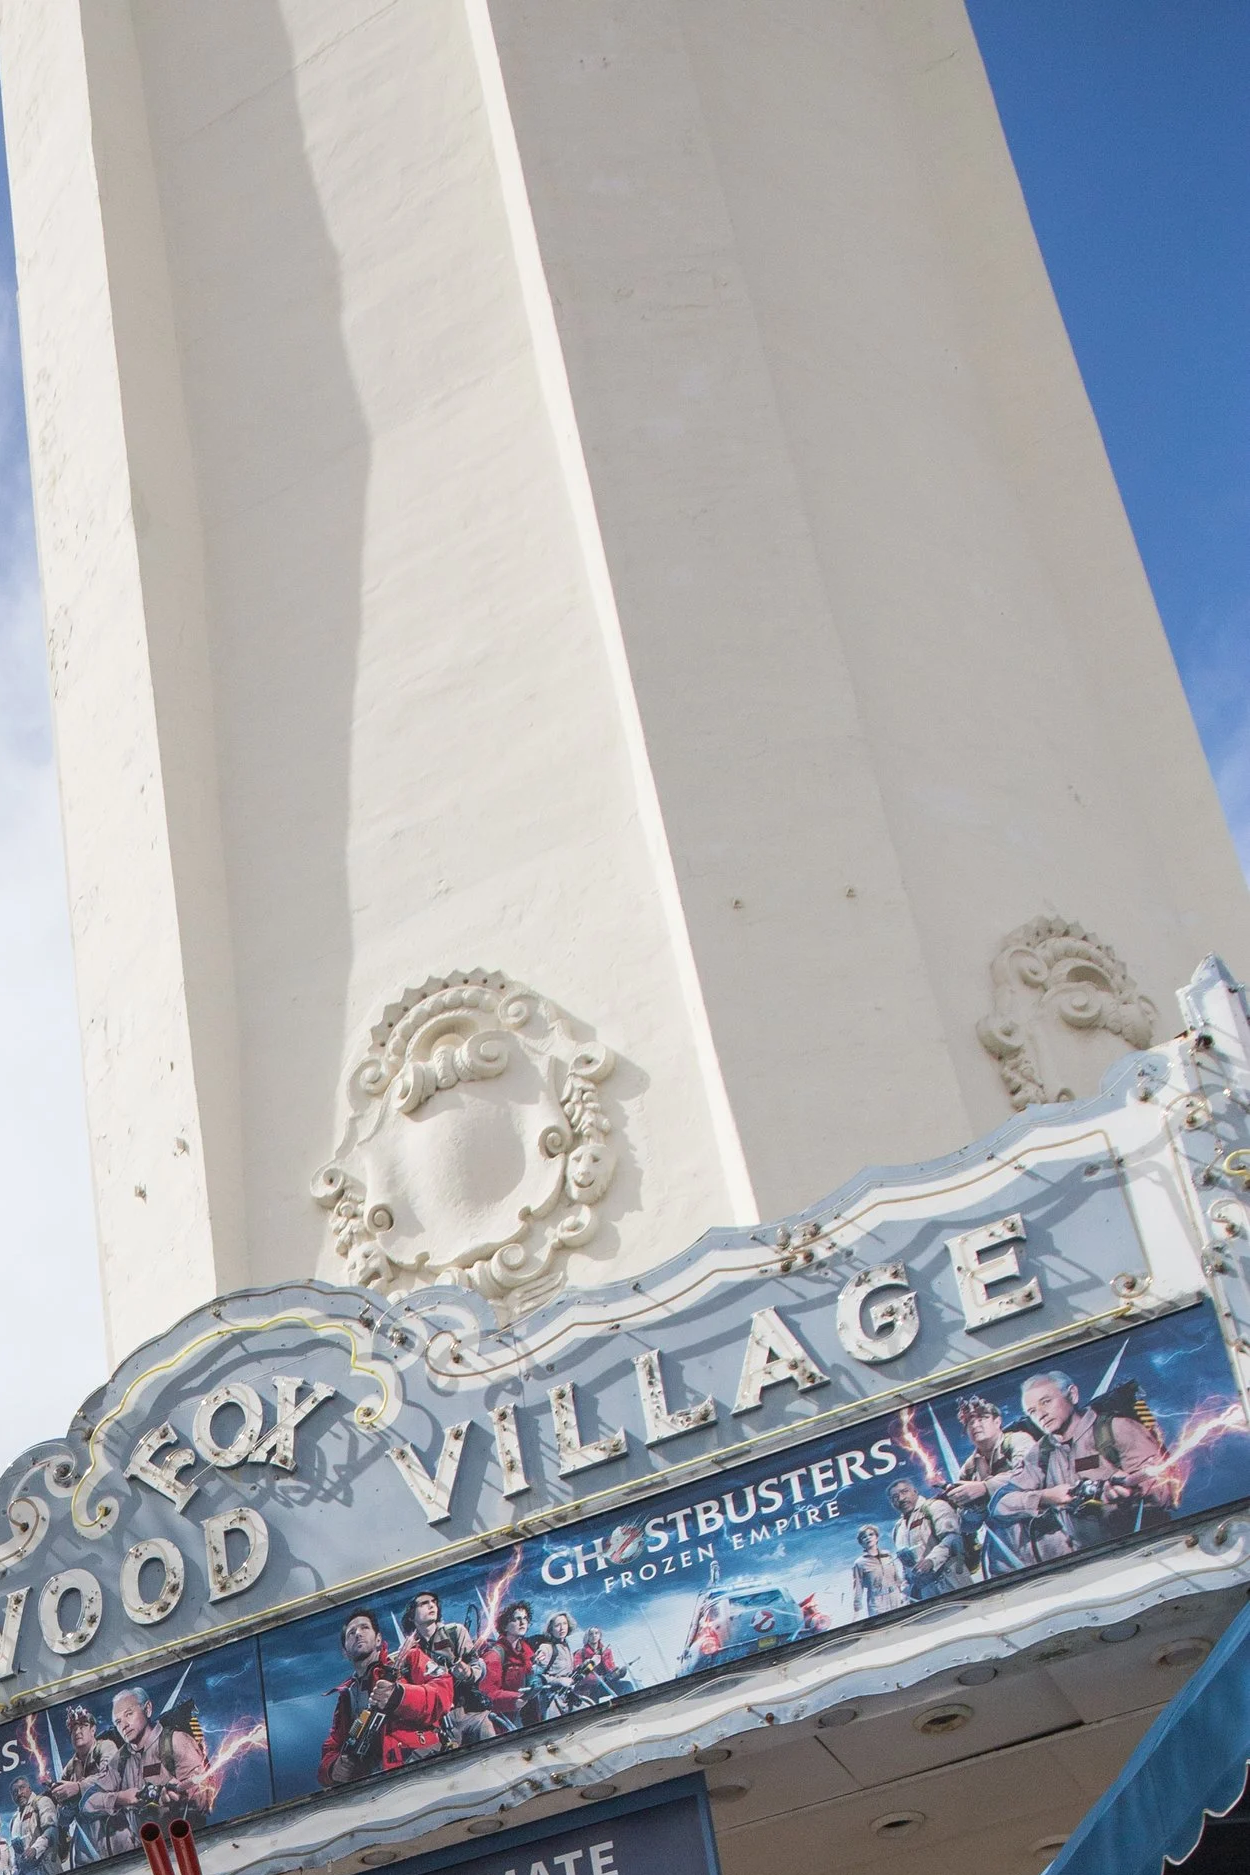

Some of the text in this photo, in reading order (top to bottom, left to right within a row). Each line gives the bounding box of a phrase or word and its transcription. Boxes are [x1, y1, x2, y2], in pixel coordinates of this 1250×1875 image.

[386, 1212, 1043, 1525] VILLAGE
[123, 1375, 337, 1513] FOX
[605, 1500, 841, 1593] FROZEN EMPIRE
